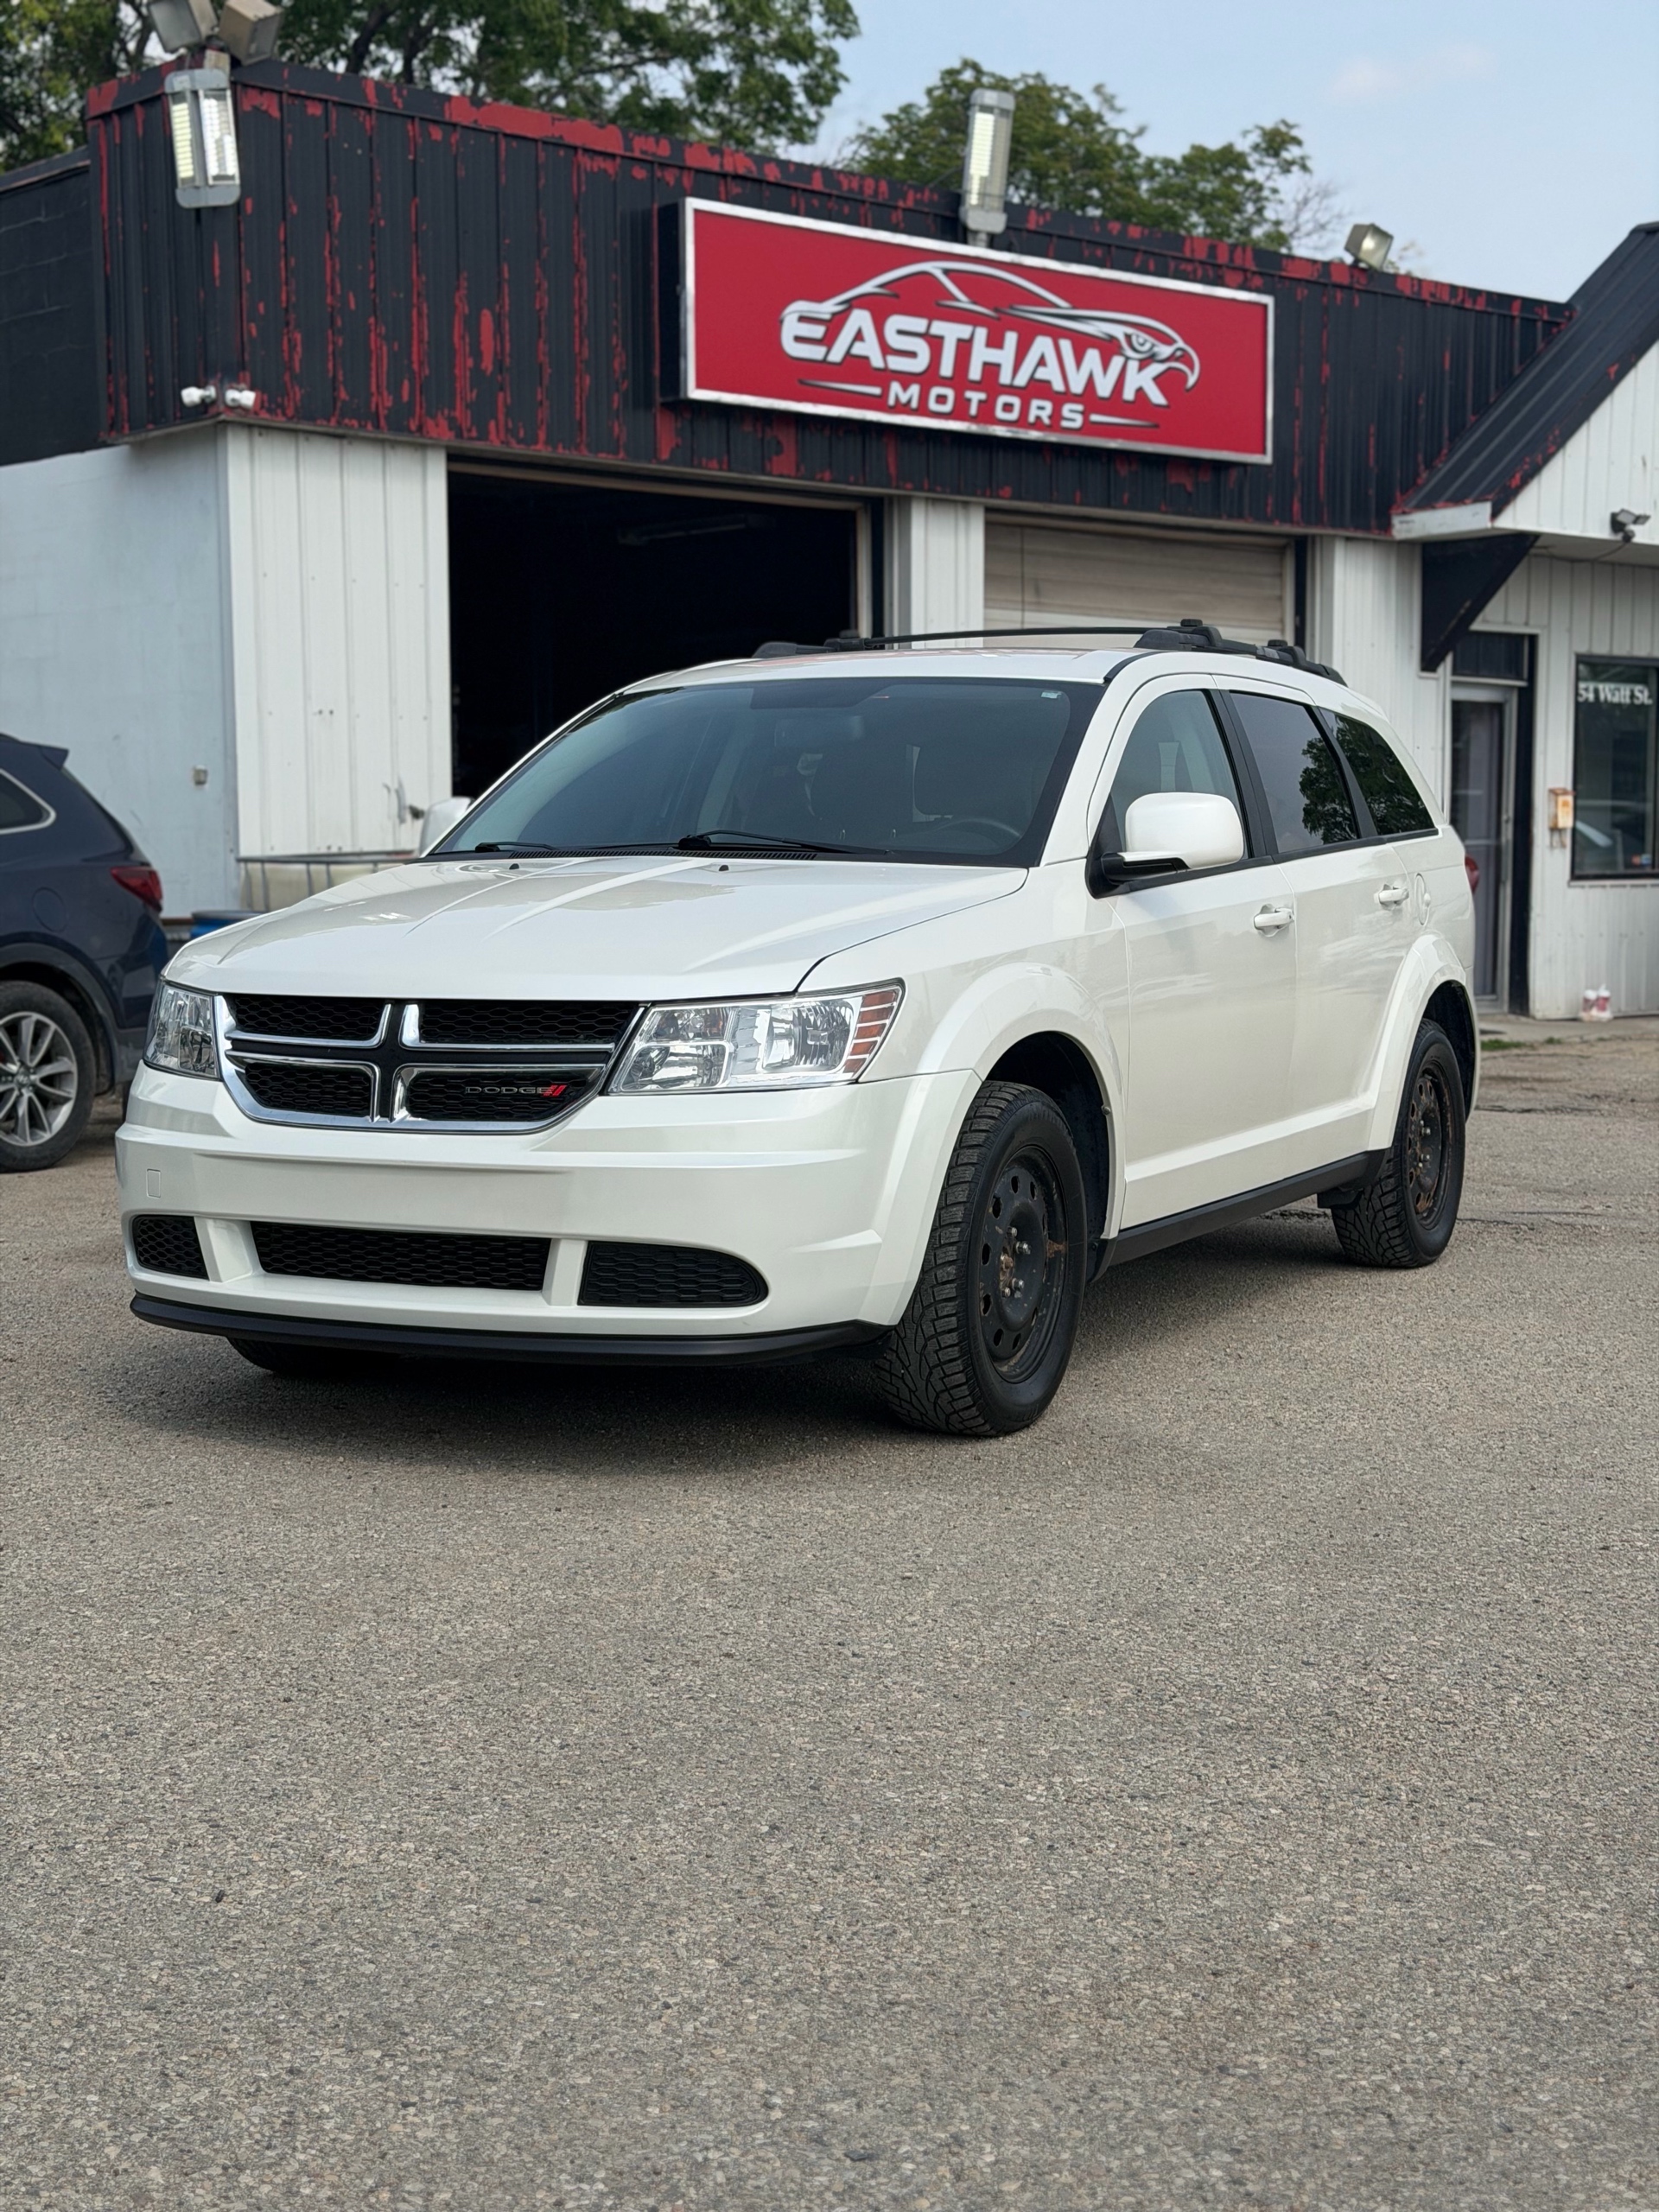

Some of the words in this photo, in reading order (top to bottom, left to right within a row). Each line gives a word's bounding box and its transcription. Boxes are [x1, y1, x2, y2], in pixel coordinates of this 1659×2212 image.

[780, 305, 1169, 407] EASTHAWK
[887, 380, 1084, 429] MOTORS
[1599, 683, 1630, 704] Watt
[466, 1086, 553, 1095] DODGE
